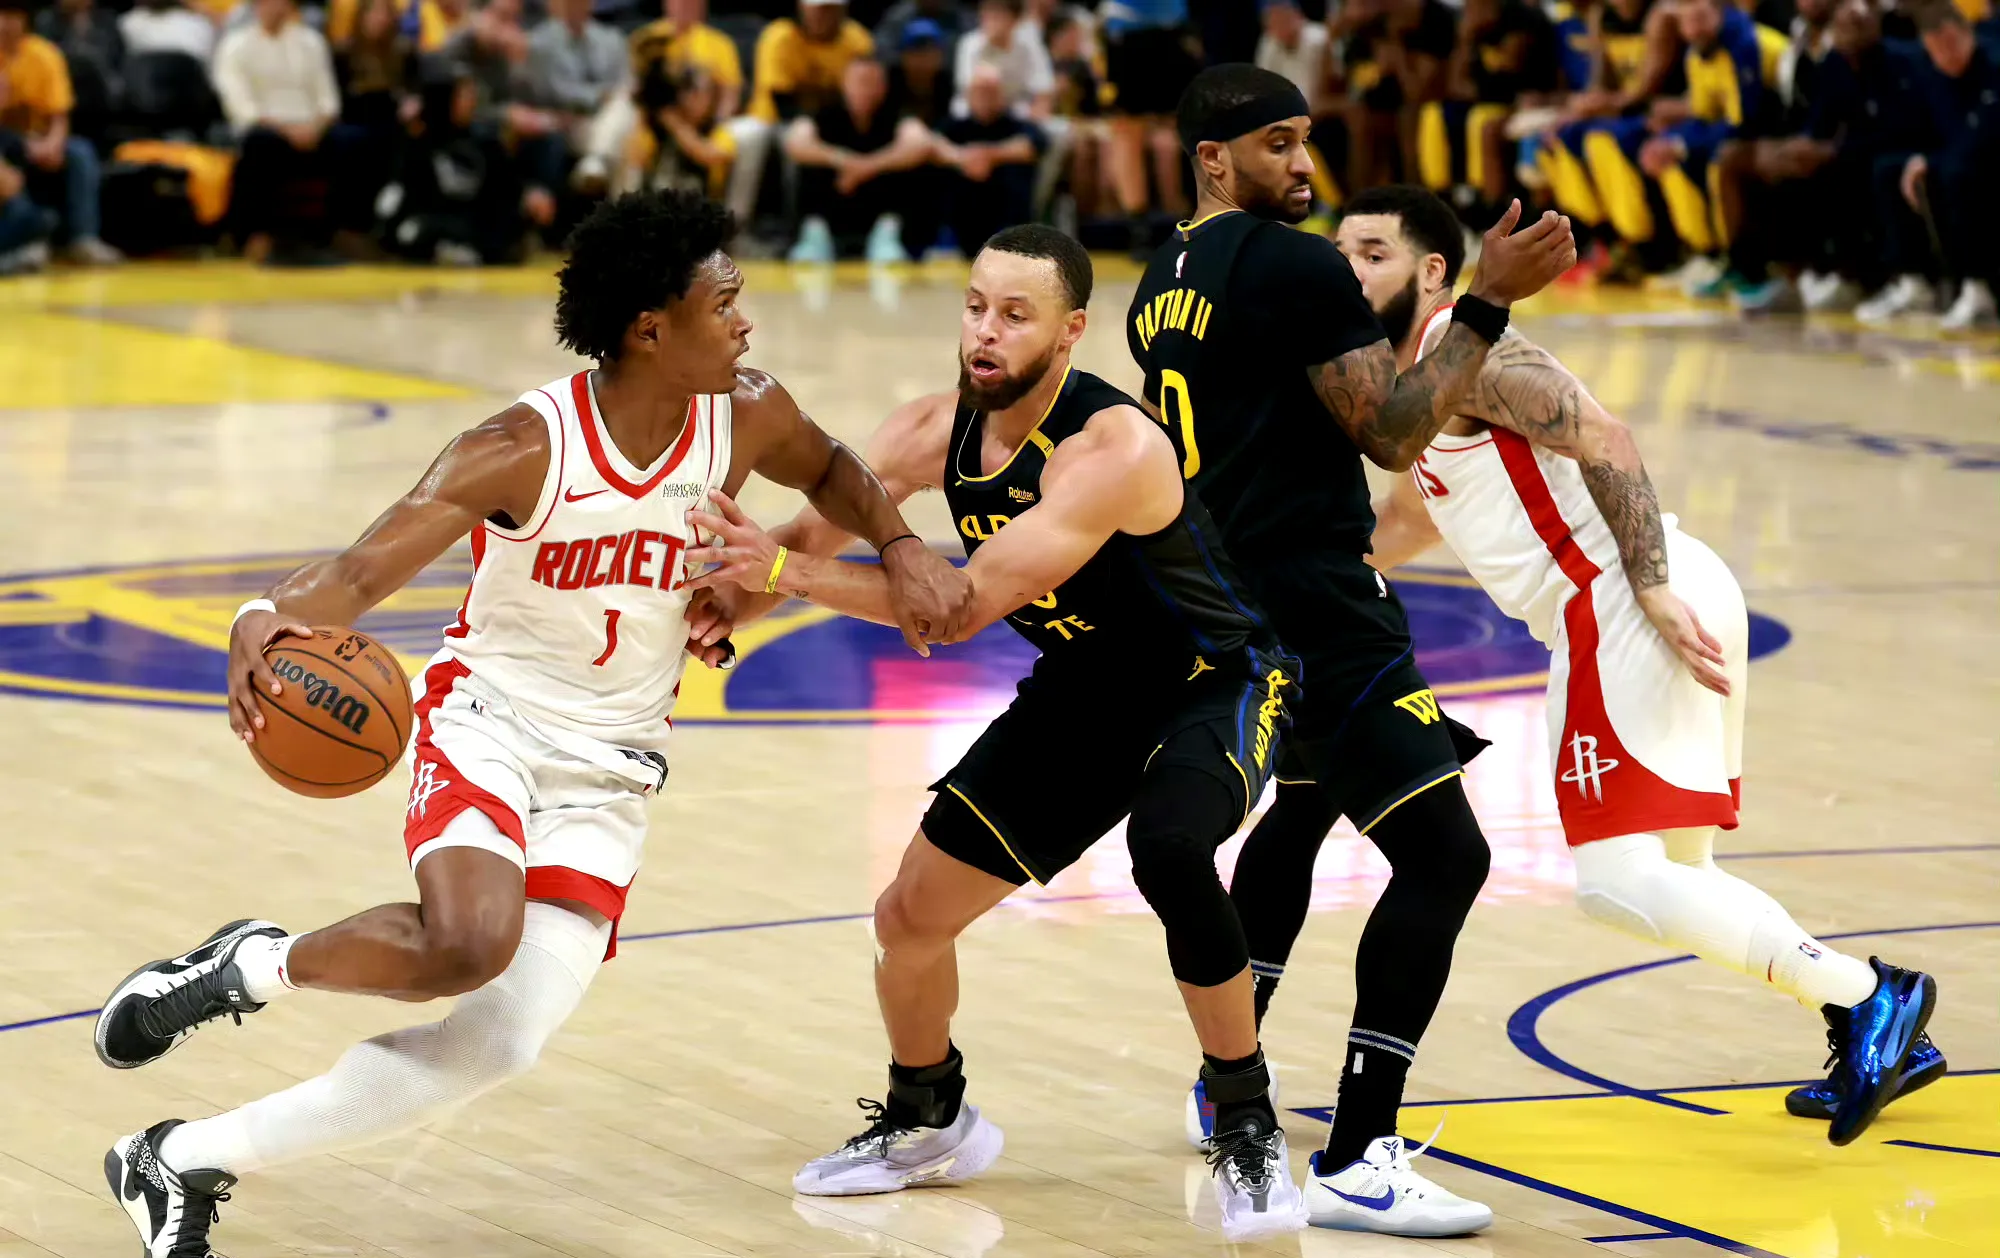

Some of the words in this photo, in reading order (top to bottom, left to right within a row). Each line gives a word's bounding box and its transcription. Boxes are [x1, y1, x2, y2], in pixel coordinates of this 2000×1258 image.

[1135, 288, 1196, 352] PAYTON
[1191, 295, 1213, 342] II
[1160, 368, 1201, 480] 0
[592, 608, 622, 667] 1
[272, 656, 370, 735] Wilson
